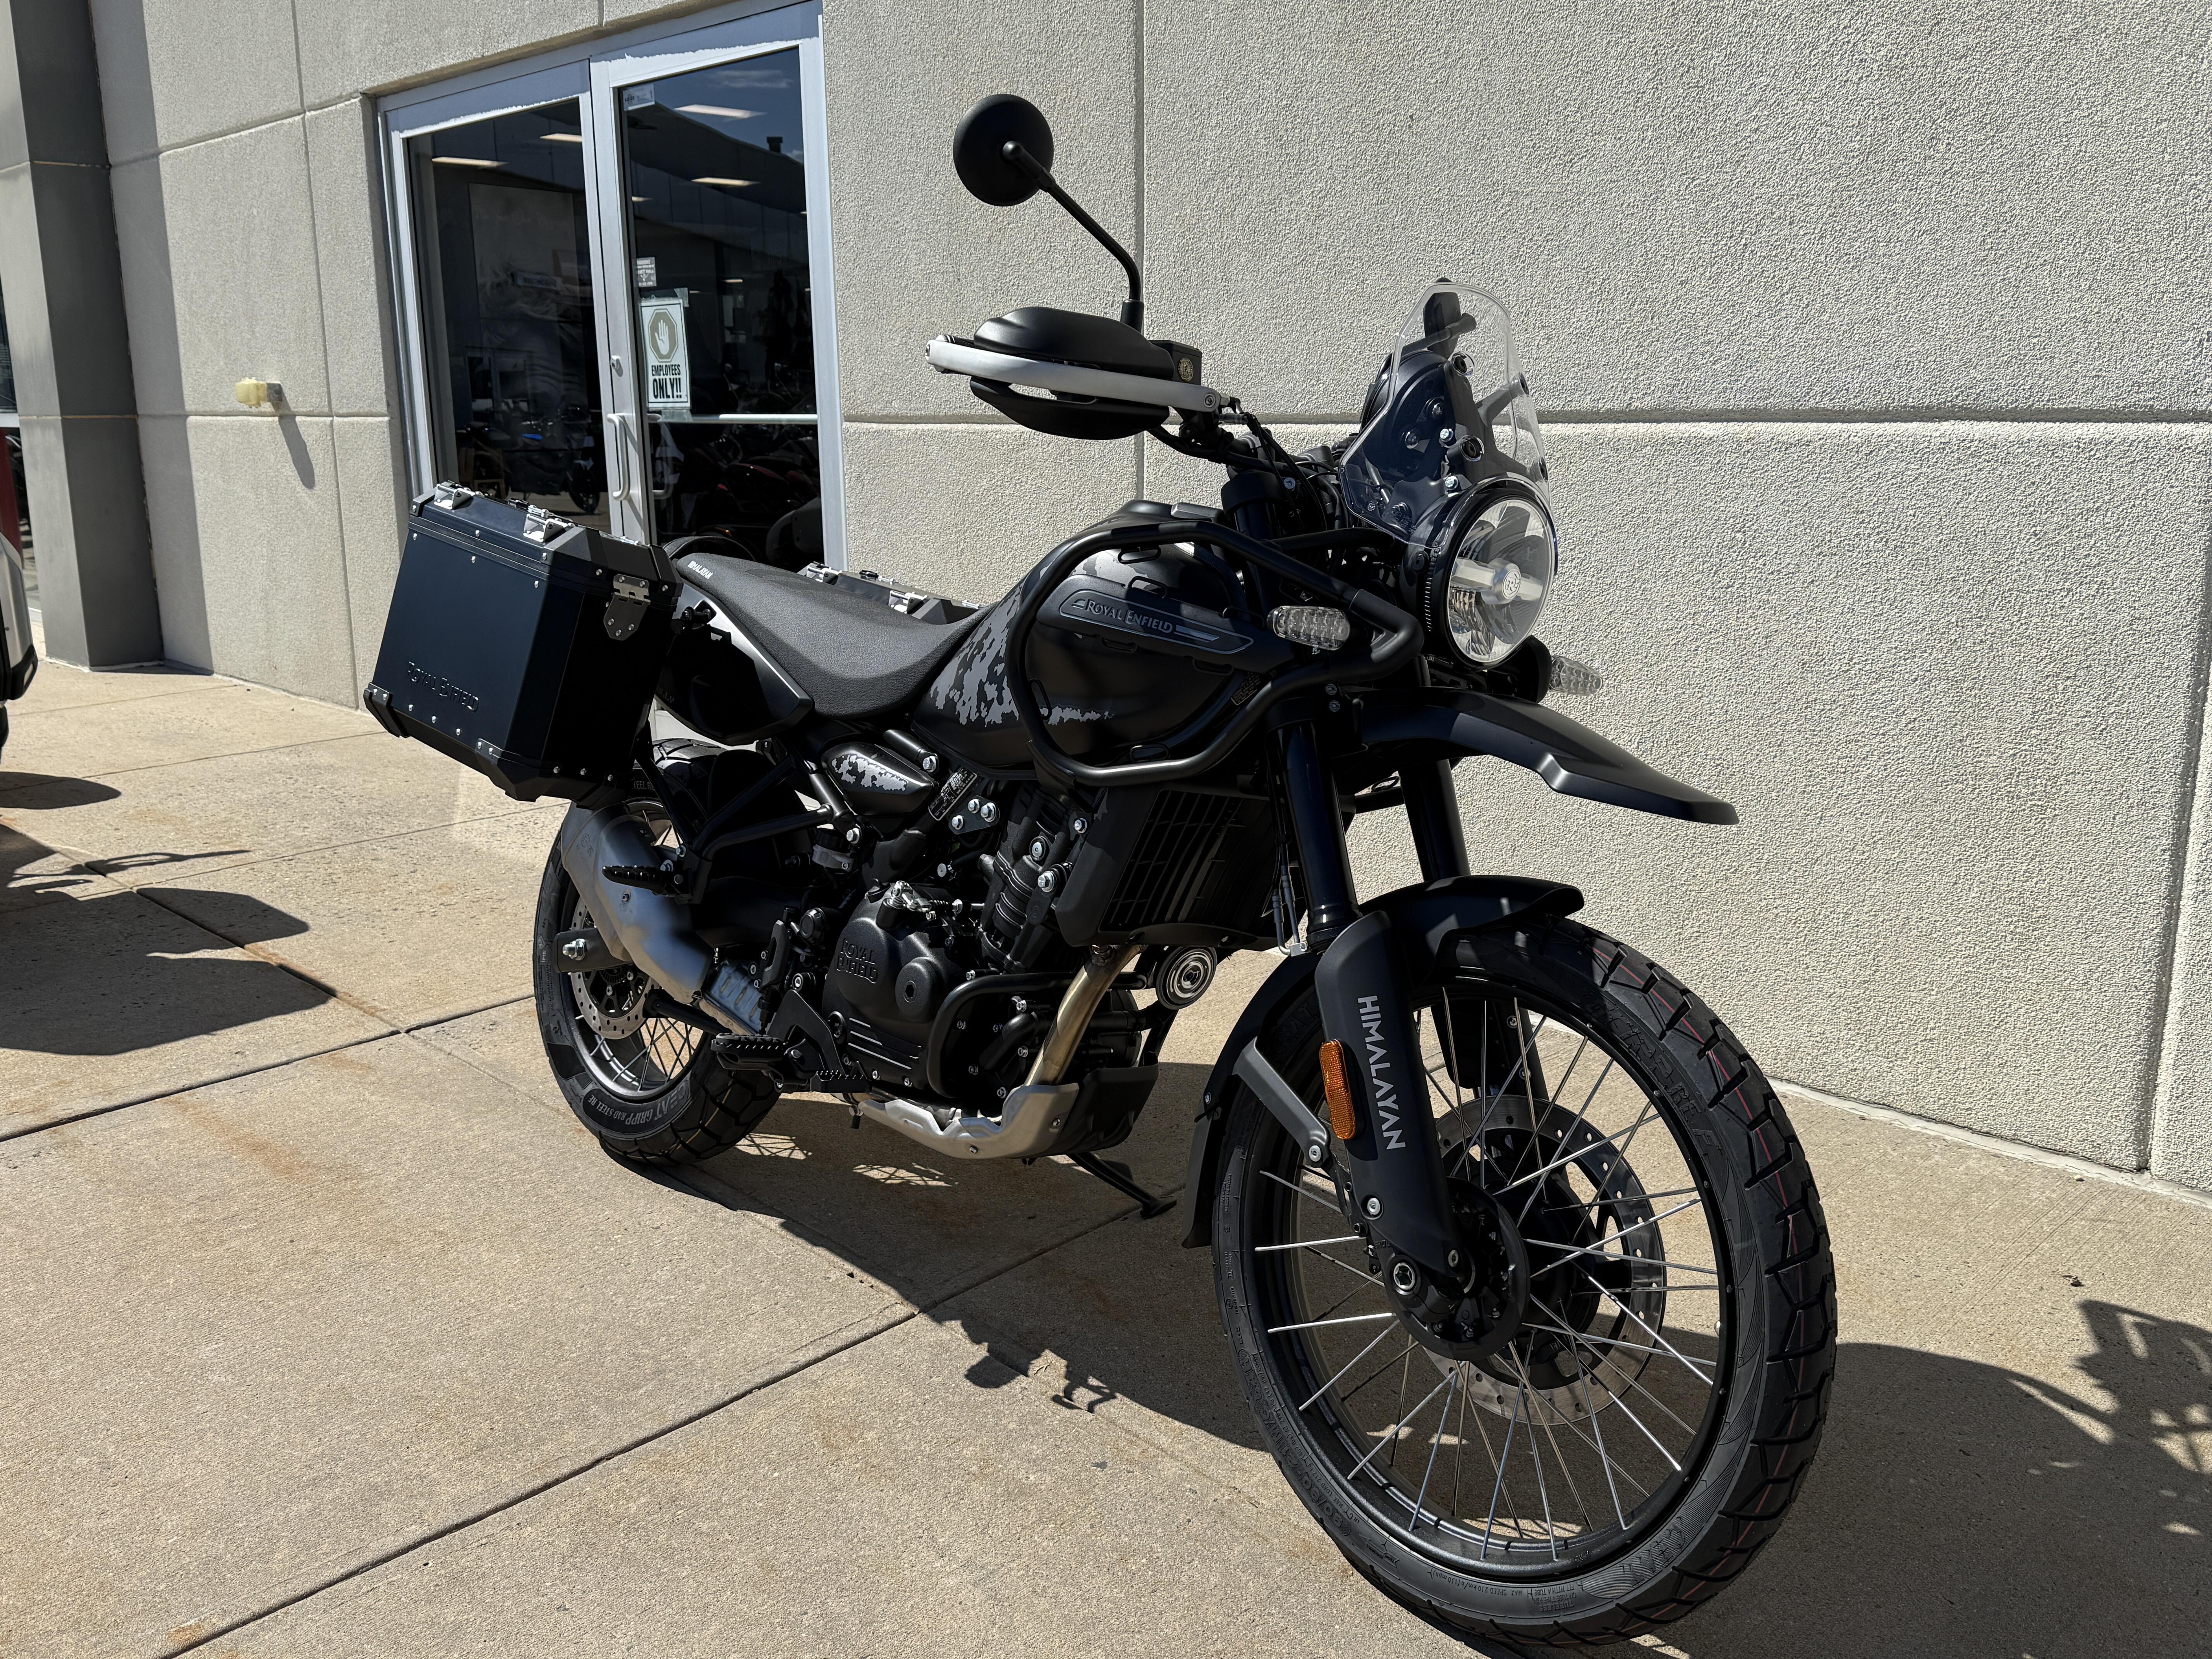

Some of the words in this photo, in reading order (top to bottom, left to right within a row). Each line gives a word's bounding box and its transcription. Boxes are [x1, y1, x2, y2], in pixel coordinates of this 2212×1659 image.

[651, 364, 681, 376] EMPLOYEES
[653, 378, 682, 399] ONLY!!
[1087, 599, 1122, 620] ROYAL
[1125, 610, 1173, 634] ENFIELD
[407, 661, 437, 692] ROYAL
[438, 677, 479, 713] ENFIELD
[840, 938, 875, 964] ROYAL
[836, 955, 878, 984] ENFIELD
[1358, 995, 1406, 1150] HIMALAYAN
[587, 1094, 598, 1106] RE
[654, 1084, 687, 1120] CEAT
[596, 1103, 614, 1117] STEEL
[613, 1111, 627, 1121] RAD
[625, 1109, 653, 1125] GRIPP
[1319, 1482, 1334, 1497] LOAD
[1332, 1496, 1344, 1508] MAX
[1432, 1568, 1448, 1582] mph)
[1460, 1580, 1477, 1591] km/h
[1477, 1585, 1489, 1593] 210
[1489, 1587, 1507, 1595] SPEED
[1510, 1589, 1522, 1597] MAX
[1539, 1601, 1574, 1612] TUBELESS
